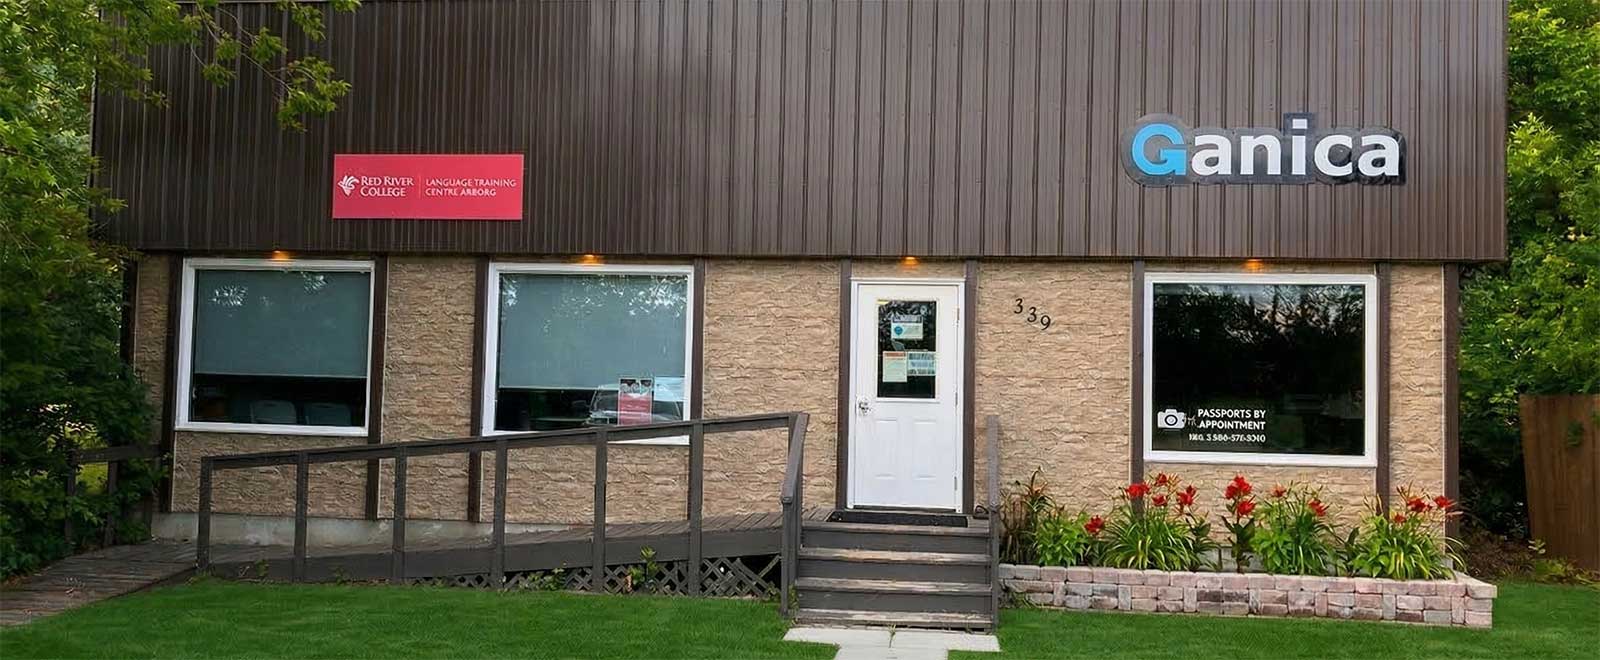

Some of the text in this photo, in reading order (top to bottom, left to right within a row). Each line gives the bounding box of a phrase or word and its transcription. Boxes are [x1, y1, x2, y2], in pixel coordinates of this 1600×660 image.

[1131, 118, 1400, 176] Ganica
[361, 175, 415, 187] RED RIVER
[425, 178, 517, 188] LANGUAGE TRAINING
[360, 186, 407, 197] COLLEGE
[425, 188, 459, 197] CENTRE
[1013, 298, 1051, 331] 339
[1197, 408, 1267, 419] PASSPORTS BY
[1199, 420, 1267, 431] APPOINTMENT
